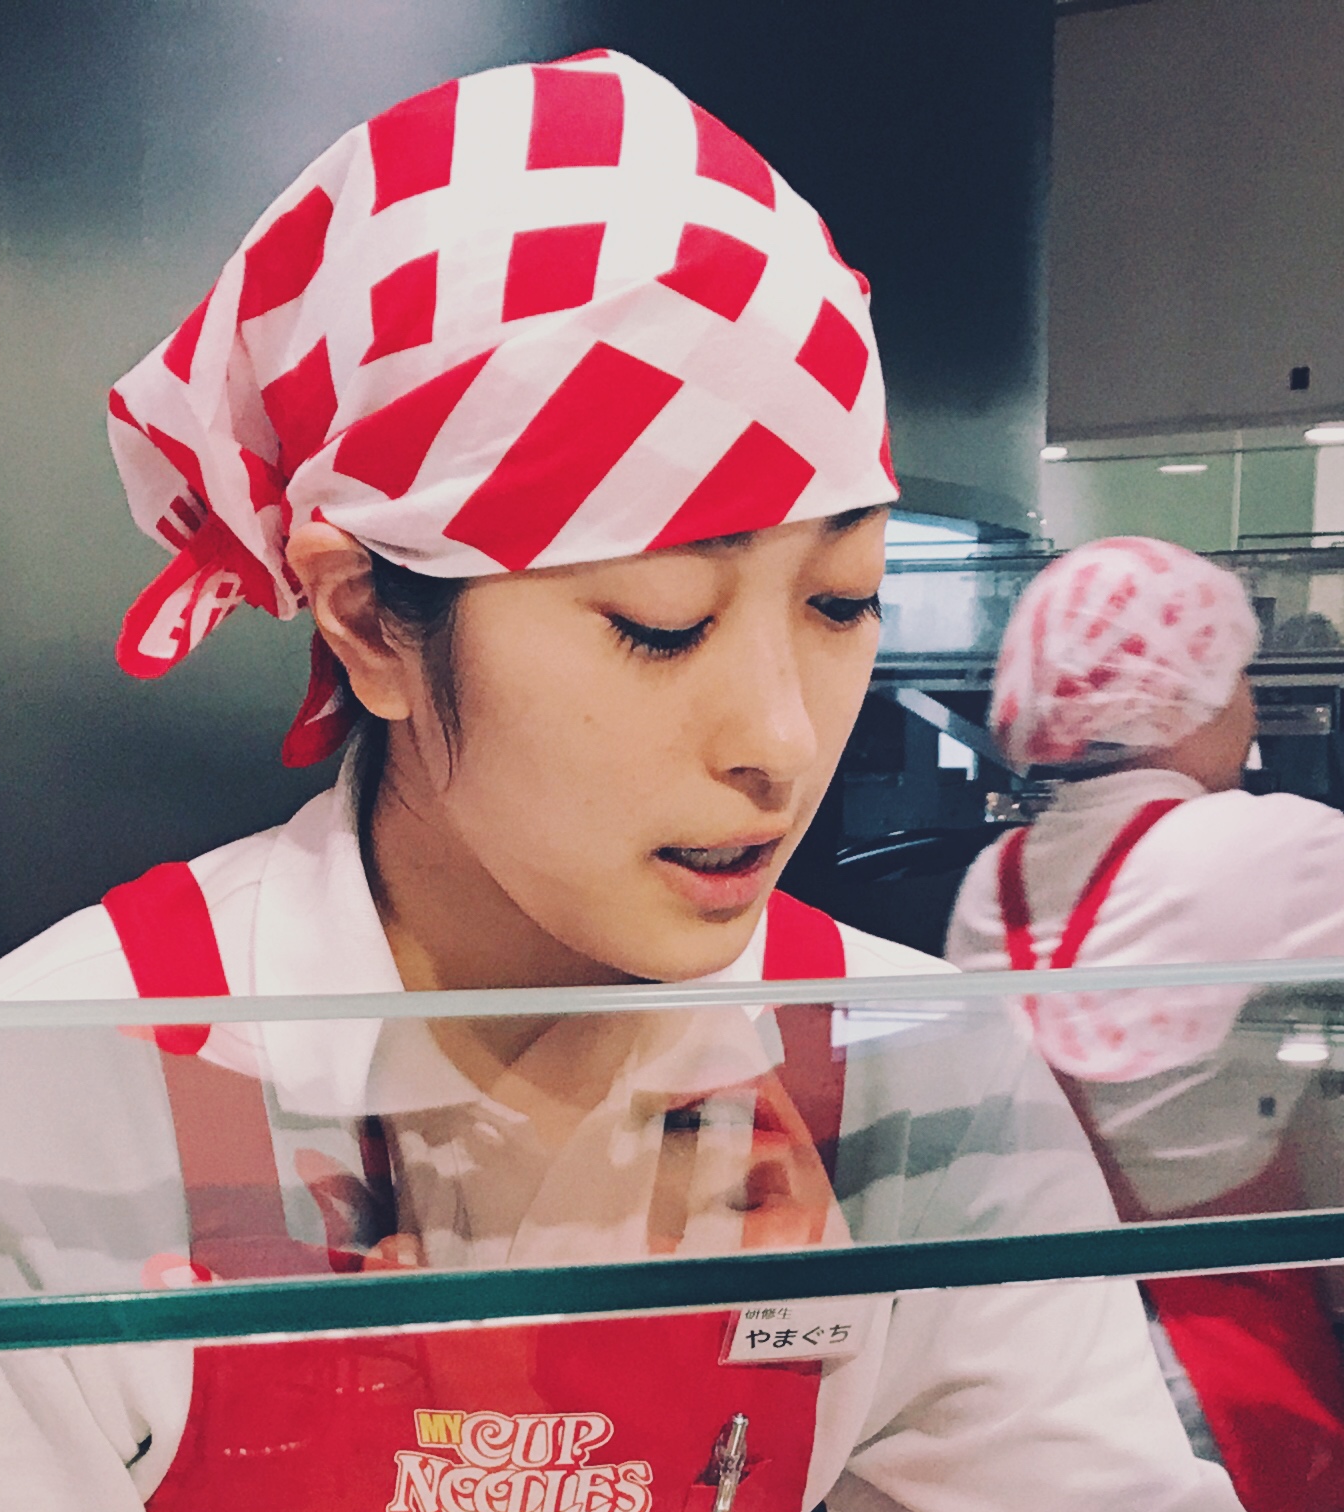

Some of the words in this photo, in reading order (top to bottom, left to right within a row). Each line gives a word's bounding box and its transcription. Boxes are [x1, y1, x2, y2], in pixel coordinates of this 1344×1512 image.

[746, 1324, 852, 1349] やまぐち
[417, 1412, 464, 1445] MY
[459, 1411, 613, 1469] CUP
